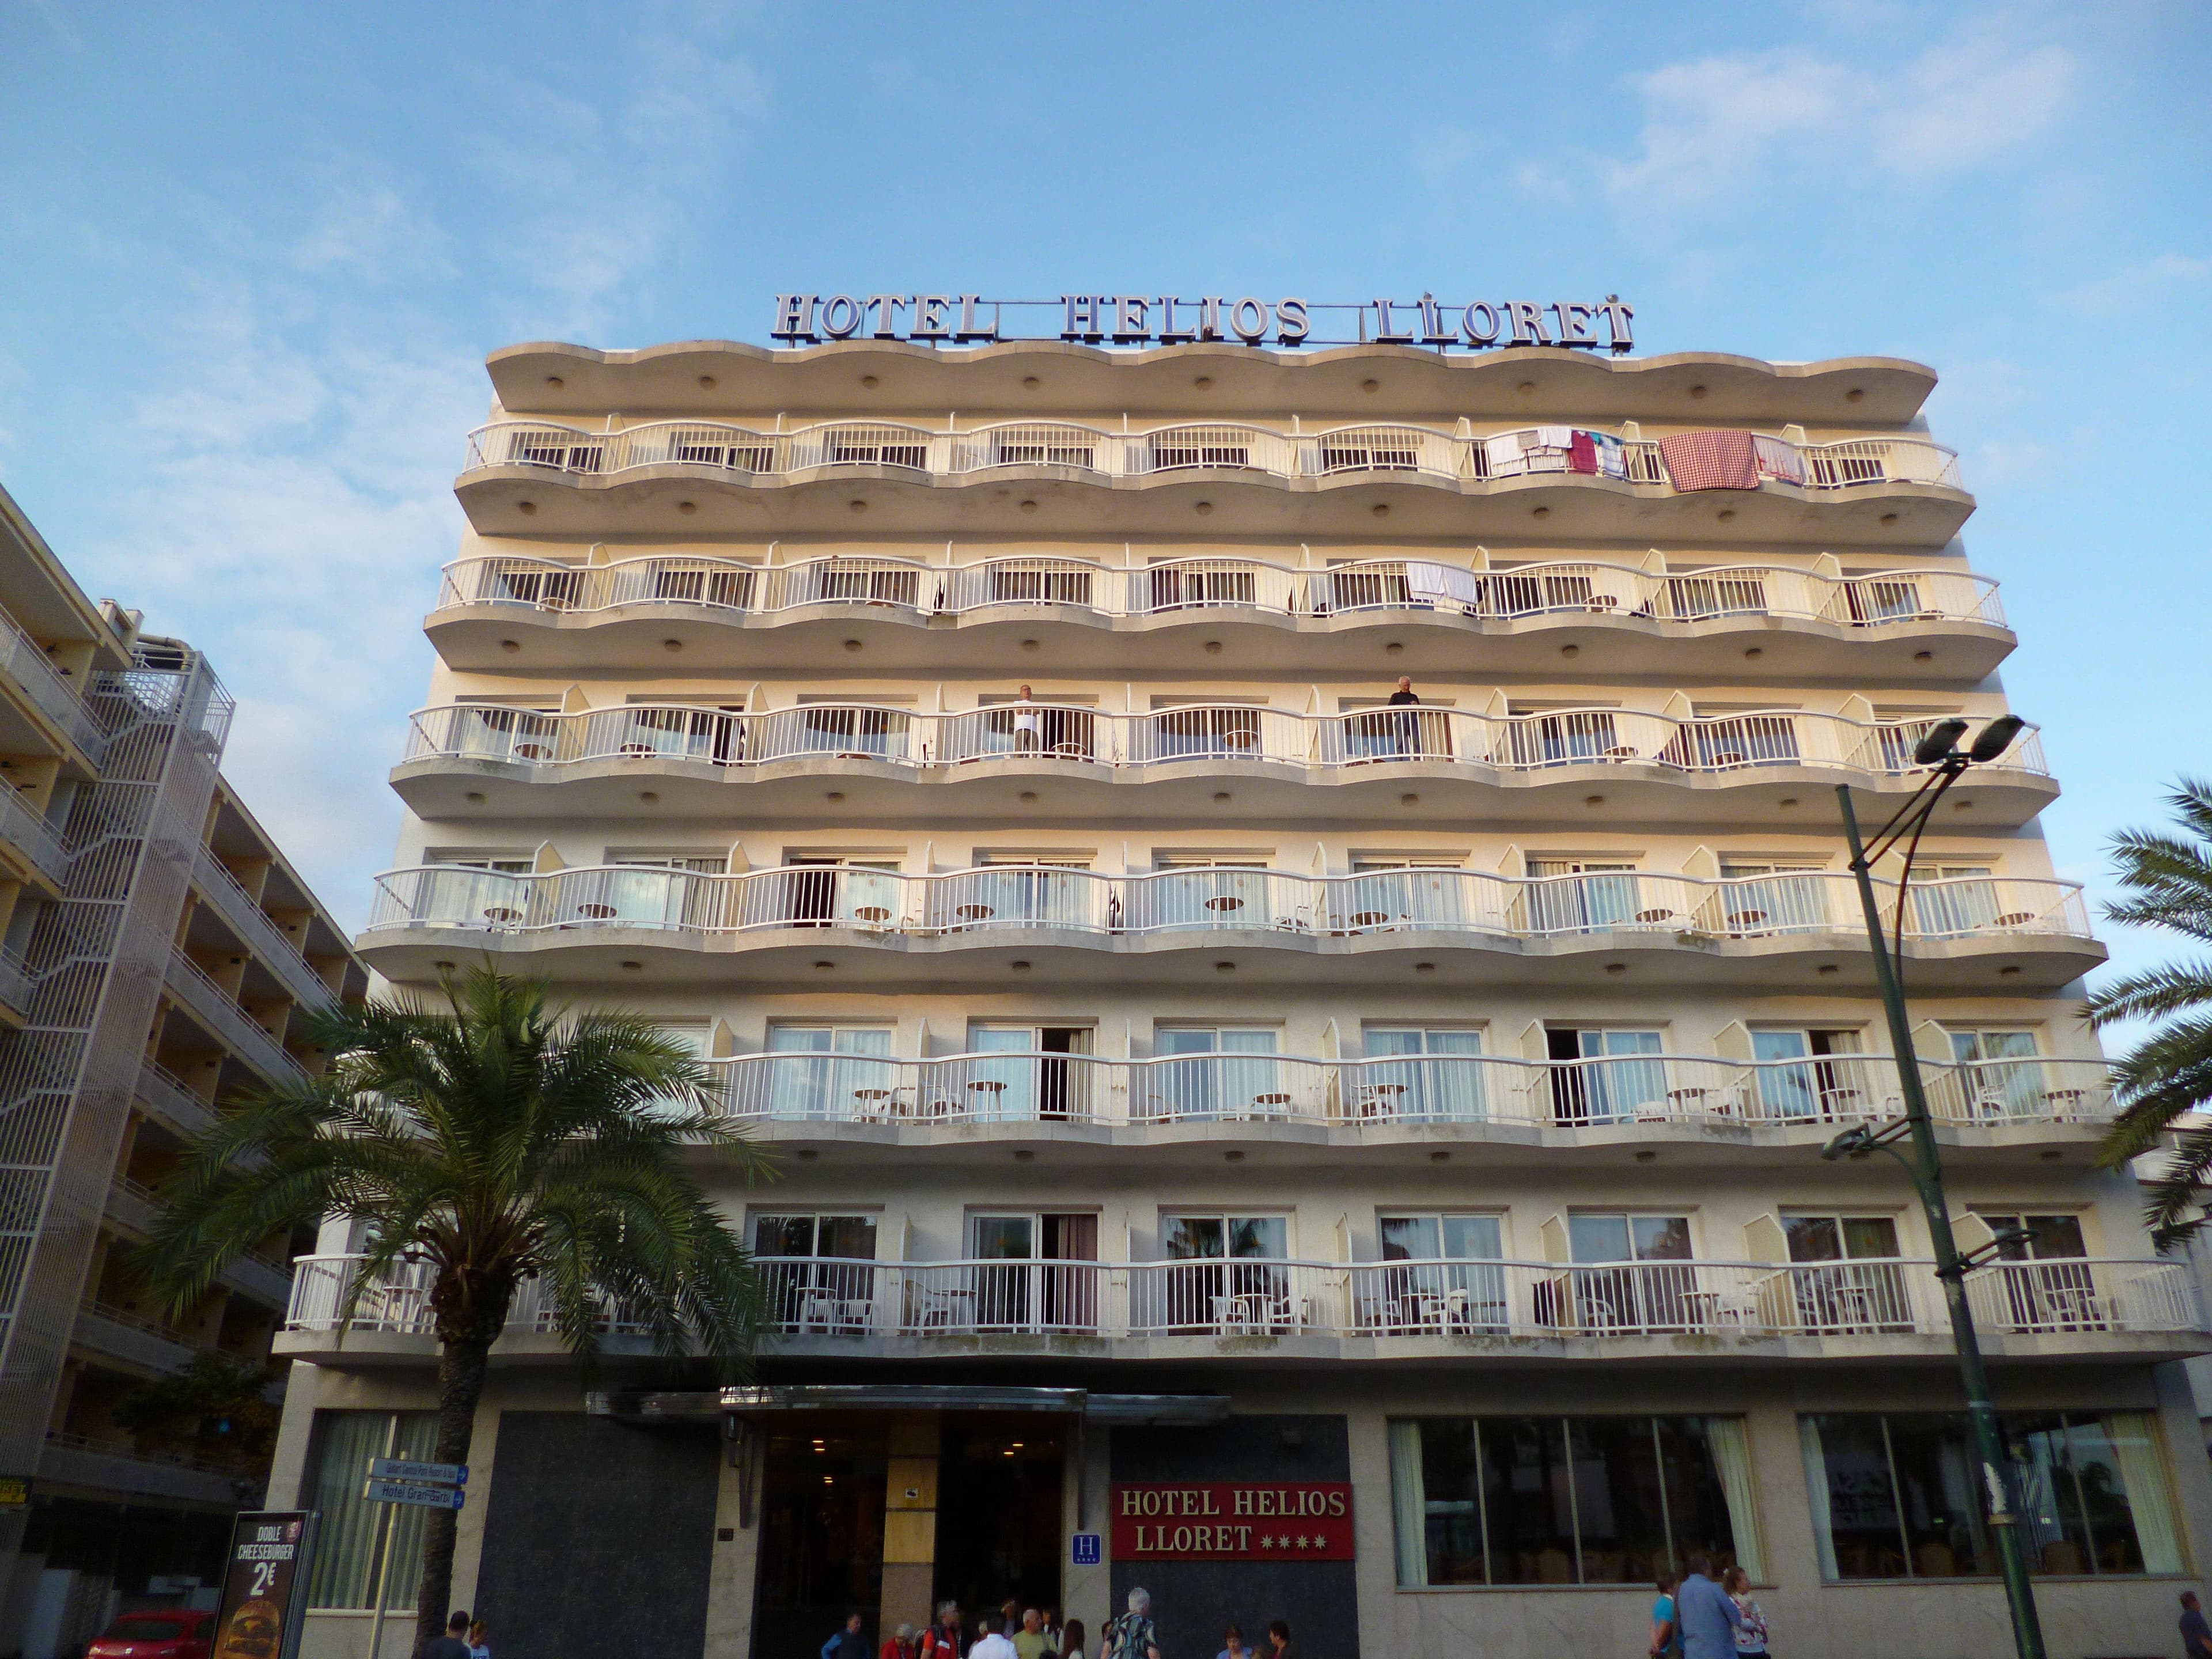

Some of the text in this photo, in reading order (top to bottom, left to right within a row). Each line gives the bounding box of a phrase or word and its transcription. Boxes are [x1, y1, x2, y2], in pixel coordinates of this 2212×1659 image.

[771, 295, 1634, 344] HOTEL HELIOS LLORET
[382, 1484, 406, 1499] Hotel
[408, 1487, 426, 1501] Gran
[1121, 1490, 1346, 1517] HOTEL HELIOS
[257, 1526, 282, 1542] DOBLE
[1135, 1525, 1252, 1551] LLORET
[237, 1544, 294, 1560] CHEESEBURGER
[1079, 1536, 1094, 1555] H
[250, 1562, 276, 1596] 2€
